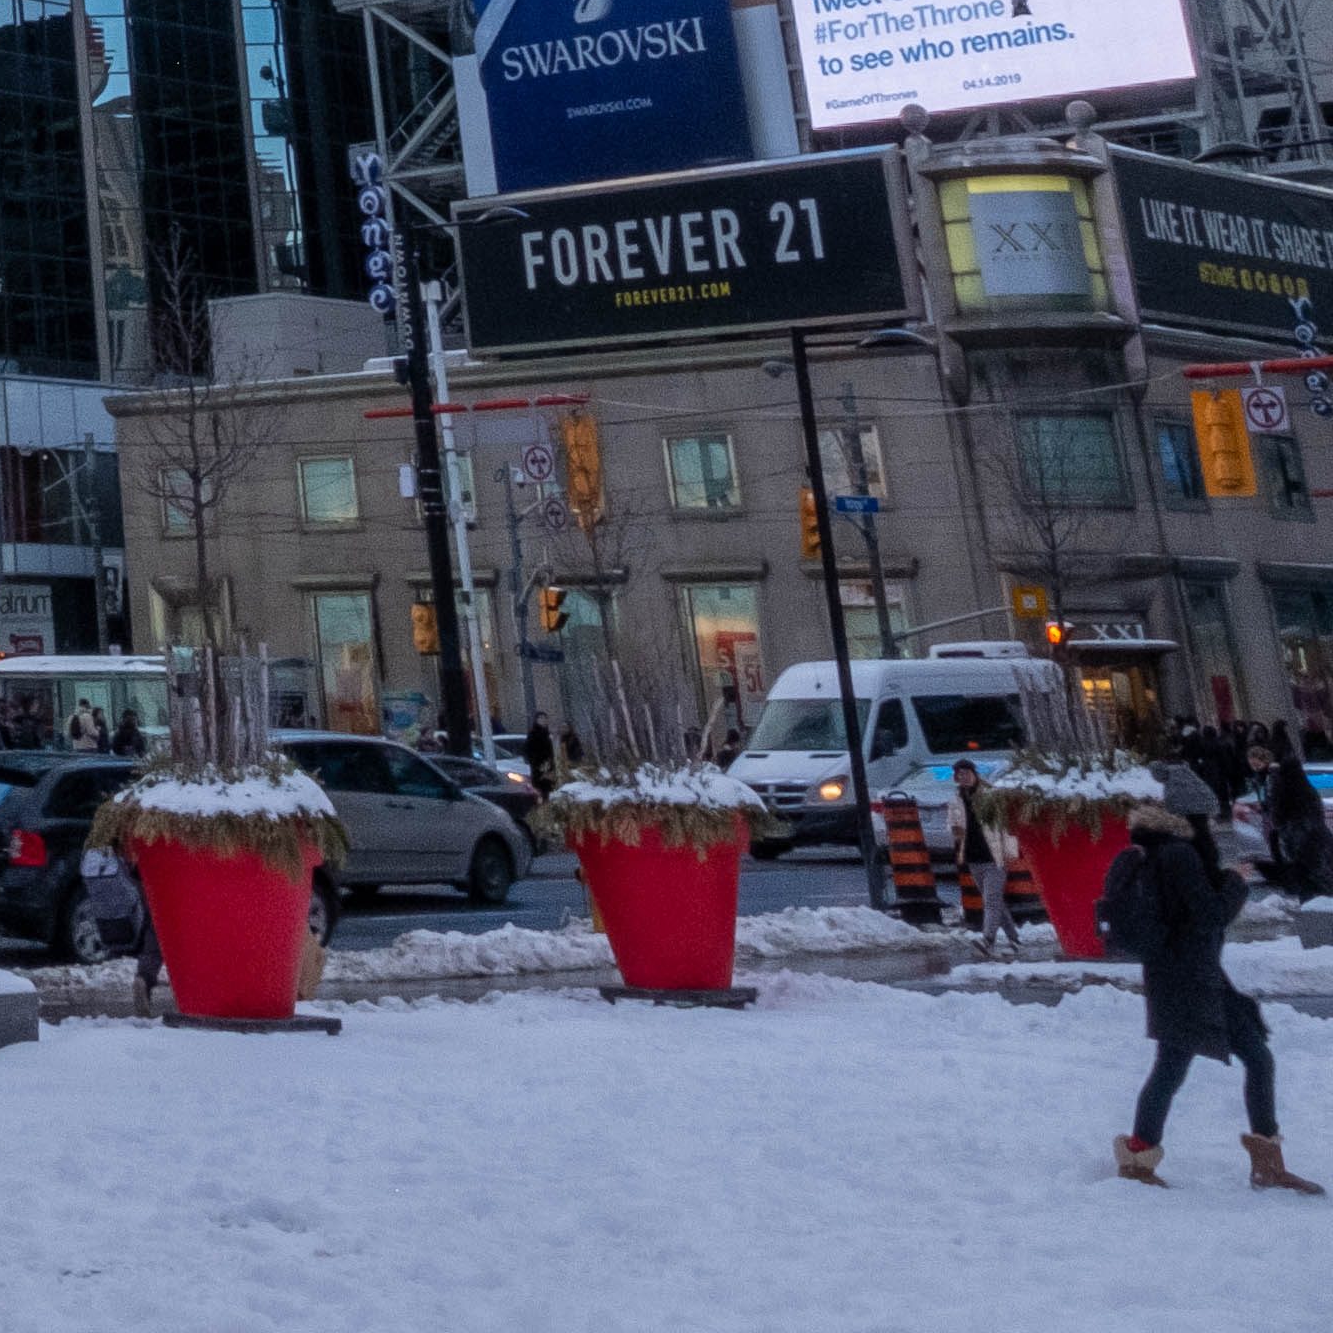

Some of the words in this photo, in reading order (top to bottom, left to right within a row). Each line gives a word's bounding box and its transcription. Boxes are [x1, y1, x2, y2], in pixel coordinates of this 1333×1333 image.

[501, 16, 708, 82] SWAROVSKI
[818, 54, 844, 77] to
[850, 48, 895, 73] see
[899, 37, 955, 65] who
[961, 20, 1076, 56] remains.
[825, 89, 919, 112] #GameOfThrones
[962, 72, 1022, 92] 04.14.2019
[520, 207, 747, 291] FOREVER
[768, 197, 825, 264] 21
[1139, 196, 1180, 244] LIKE
[1200, 208, 1253, 256] WEAR
[1271, 221, 1325, 269] SHARE
[614, 281, 732, 309] FOREVER21.COM
